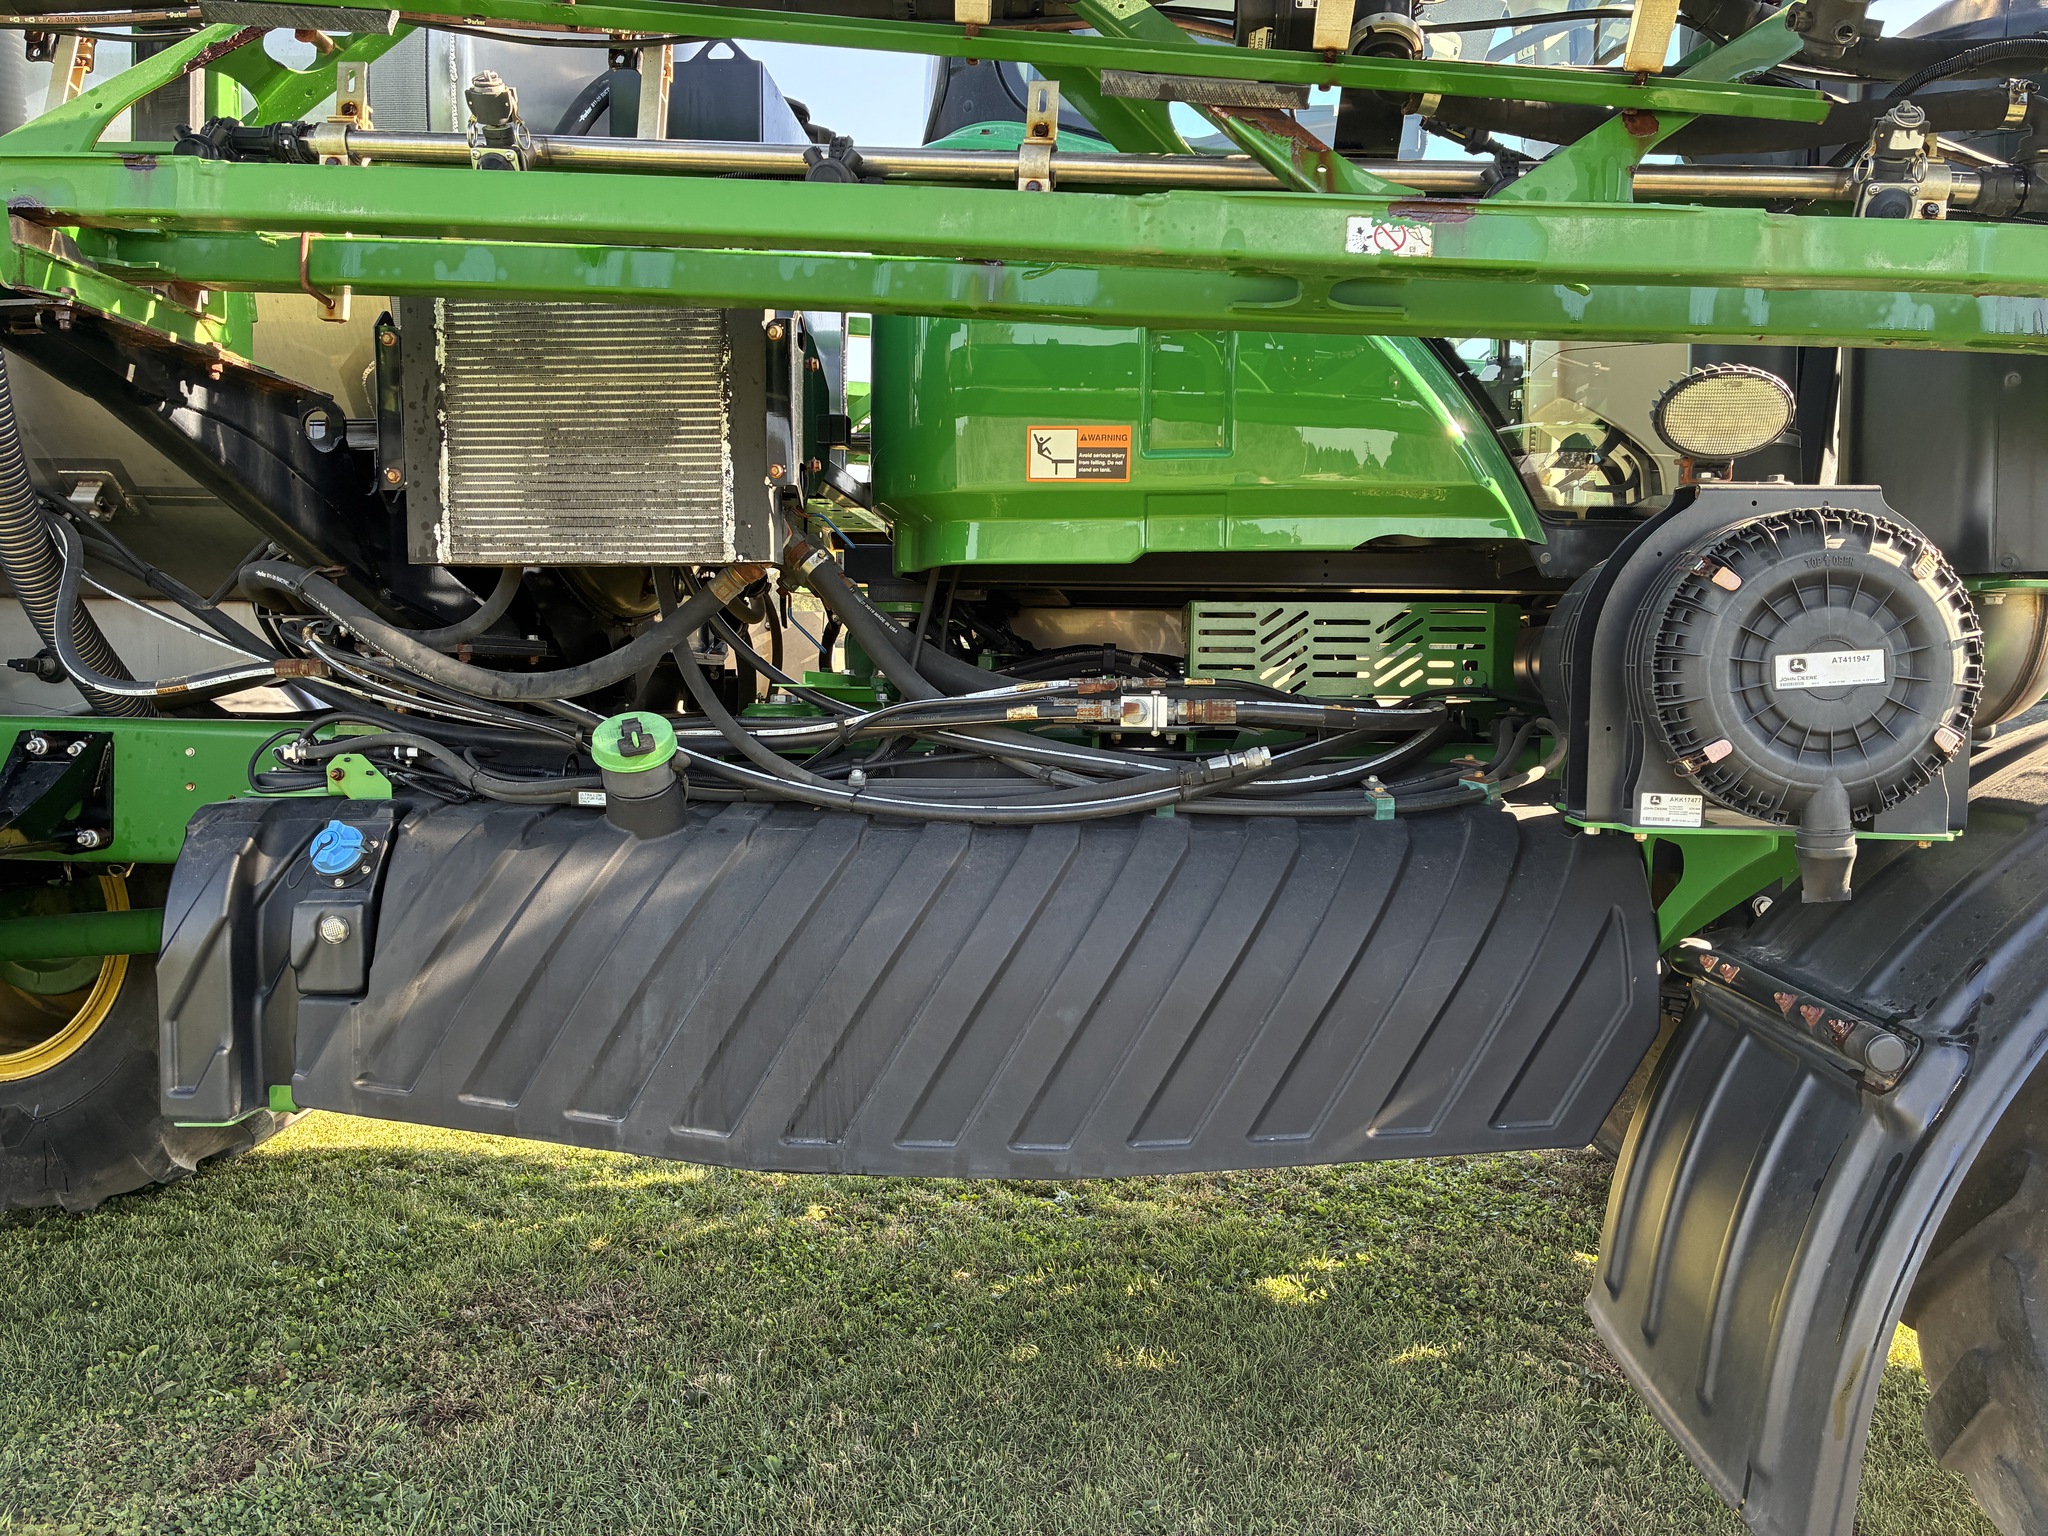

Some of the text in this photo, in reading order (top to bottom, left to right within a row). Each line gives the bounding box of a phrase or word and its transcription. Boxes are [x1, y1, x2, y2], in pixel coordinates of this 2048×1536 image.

[167, 10, 188, 18] Parker
[464, 17, 486, 26] Parker
[1087, 434, 1128, 442] WARNING
[1804, 555, 1854, 569] TOP OBEN
[873, 611, 886, 624] MADE
[1831, 655, 1871, 664] AT411947
[1669, 796, 1702, 804] AKK17477
